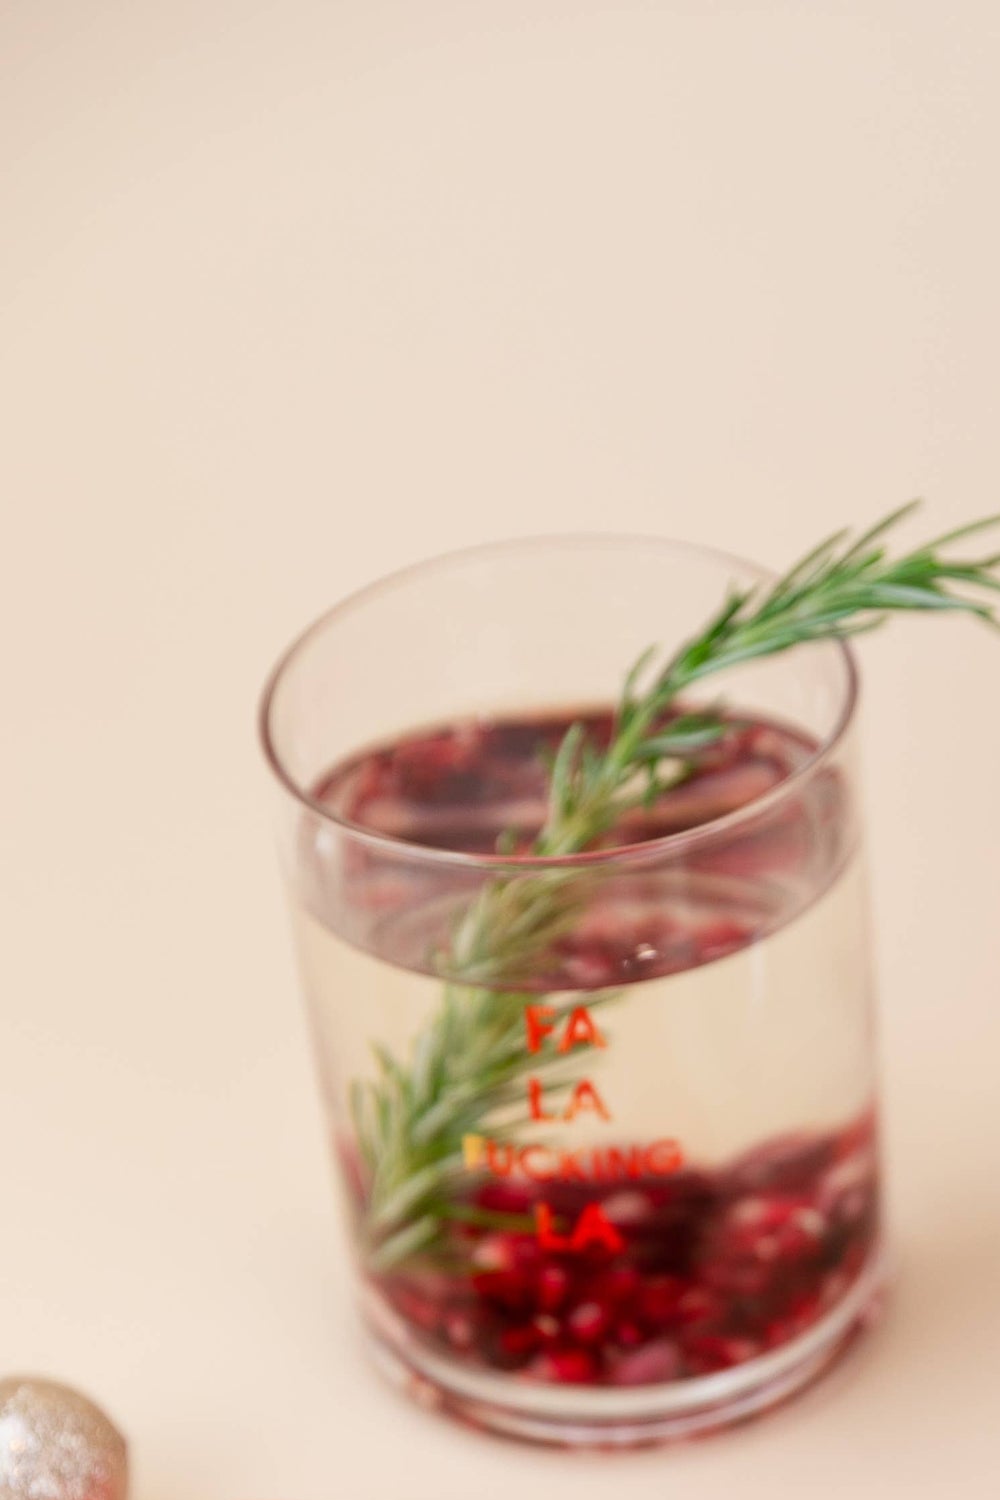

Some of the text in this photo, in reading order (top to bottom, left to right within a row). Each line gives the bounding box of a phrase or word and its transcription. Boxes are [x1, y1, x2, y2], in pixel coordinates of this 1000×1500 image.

[525, 1004, 608, 1054] FA
[528, 1077, 612, 1123] LA
[537, 1202, 626, 1254] LA
